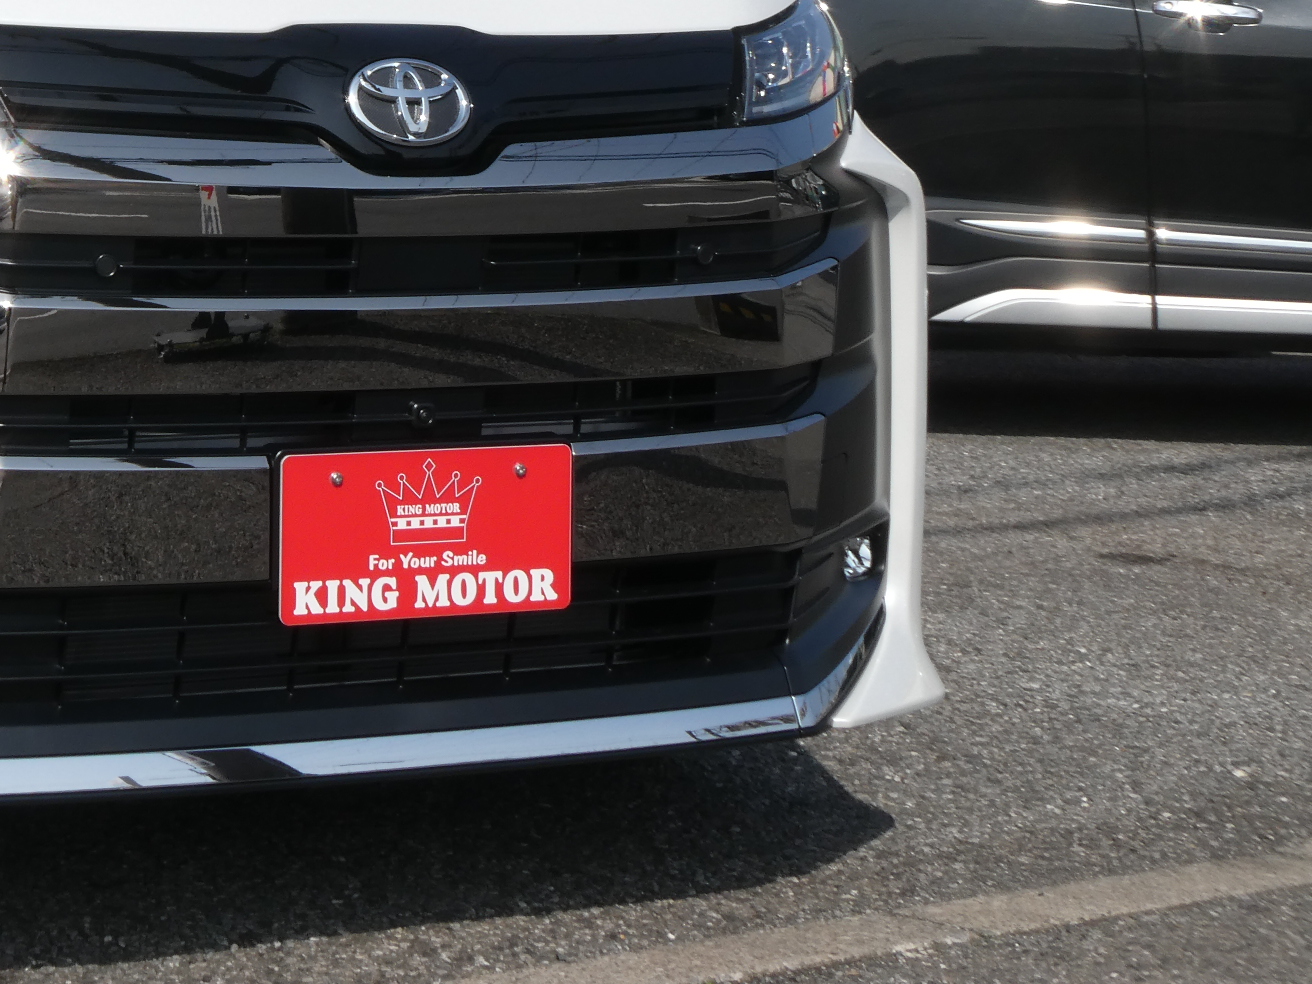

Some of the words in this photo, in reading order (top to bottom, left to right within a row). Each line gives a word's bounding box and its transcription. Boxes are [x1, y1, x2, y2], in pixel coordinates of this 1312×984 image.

[396, 504, 423, 516] KING
[425, 502, 461, 515] MOTOR
[368, 554, 395, 571] For
[399, 551, 437, 569] Your
[440, 549, 487, 566] Smile
[293, 576, 399, 616] KING
[414, 568, 558, 610] MOTOR
